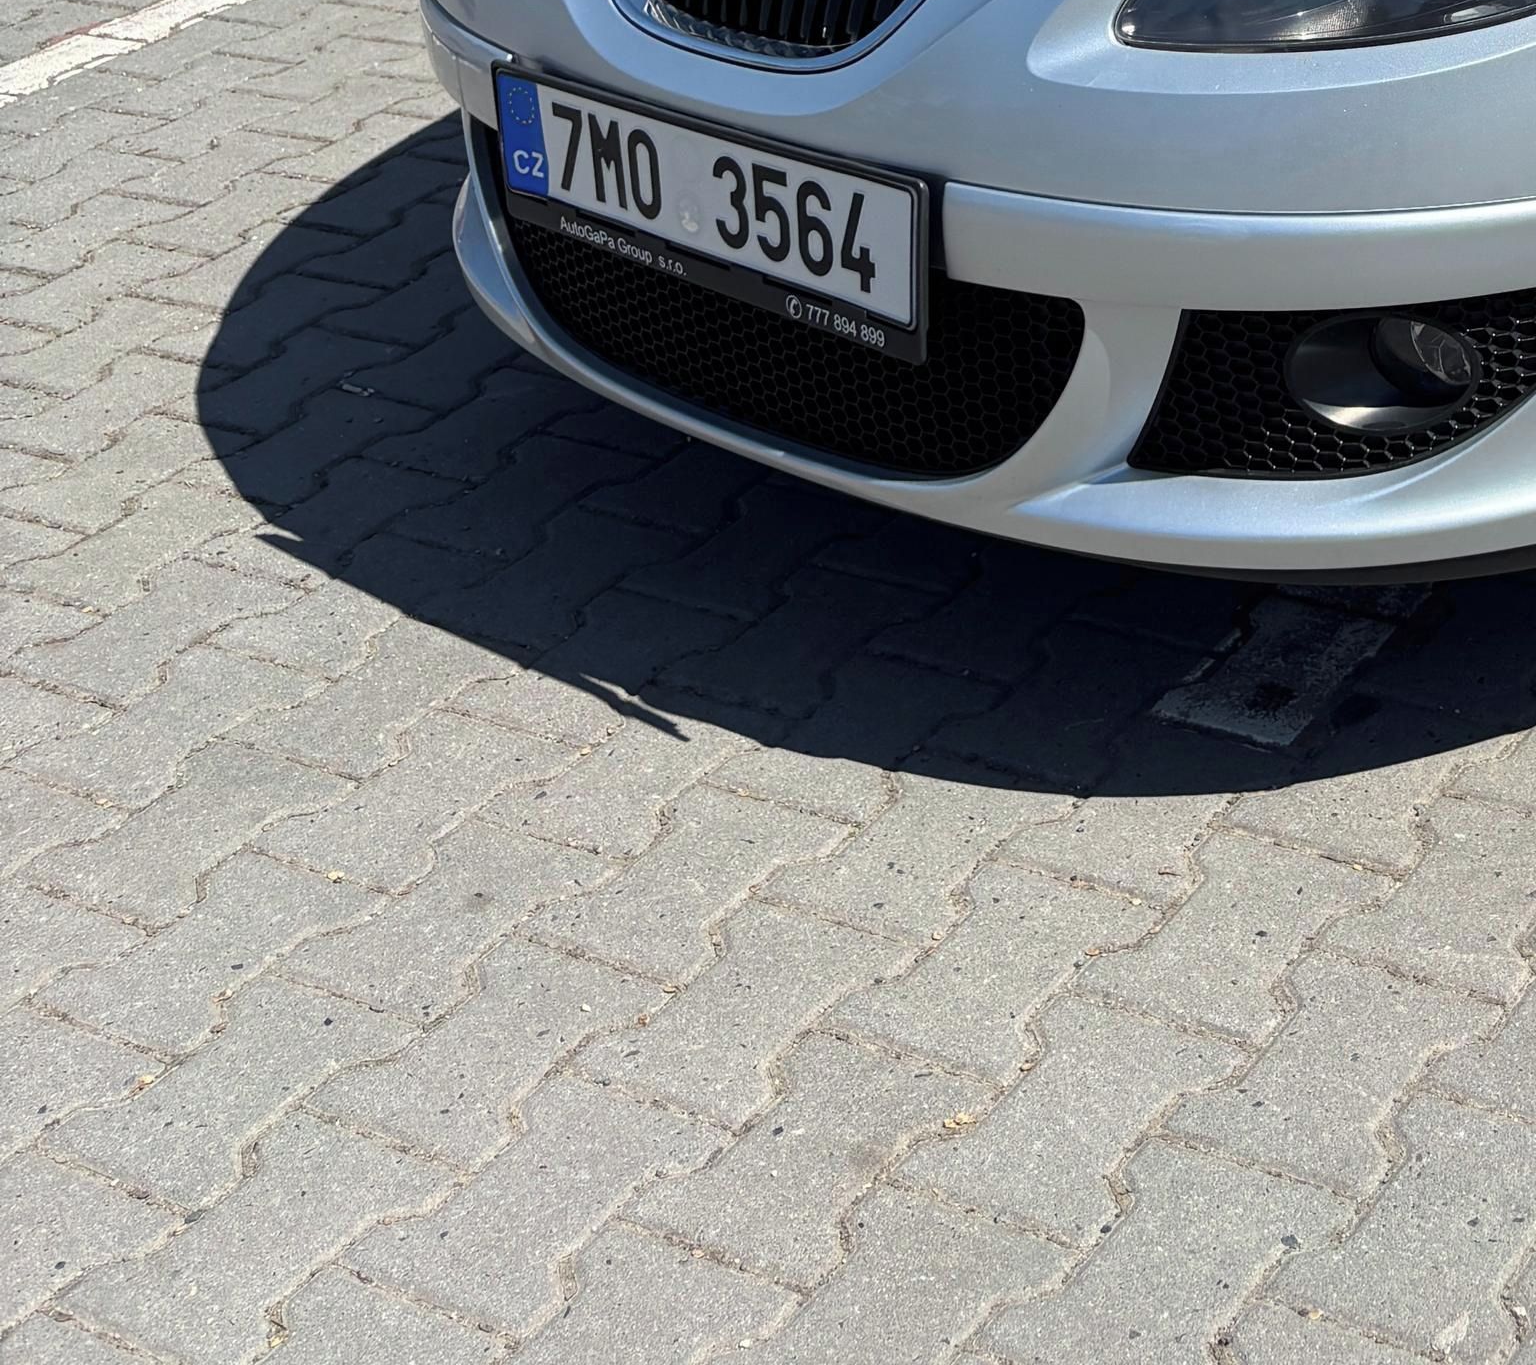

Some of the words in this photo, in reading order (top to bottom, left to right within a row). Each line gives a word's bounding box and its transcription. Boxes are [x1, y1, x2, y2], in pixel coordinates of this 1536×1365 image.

[513, 149, 545, 179] CZ
[560, 216, 615, 249] AutoGaPa
[618, 237, 653, 266] Group
[658, 255, 687, 277] s.r.o.
[713, 156, 876, 293] 3564
[806, 303, 830, 326] 777
[833, 314, 857, 337] 894
[861, 324, 885, 347] 899
